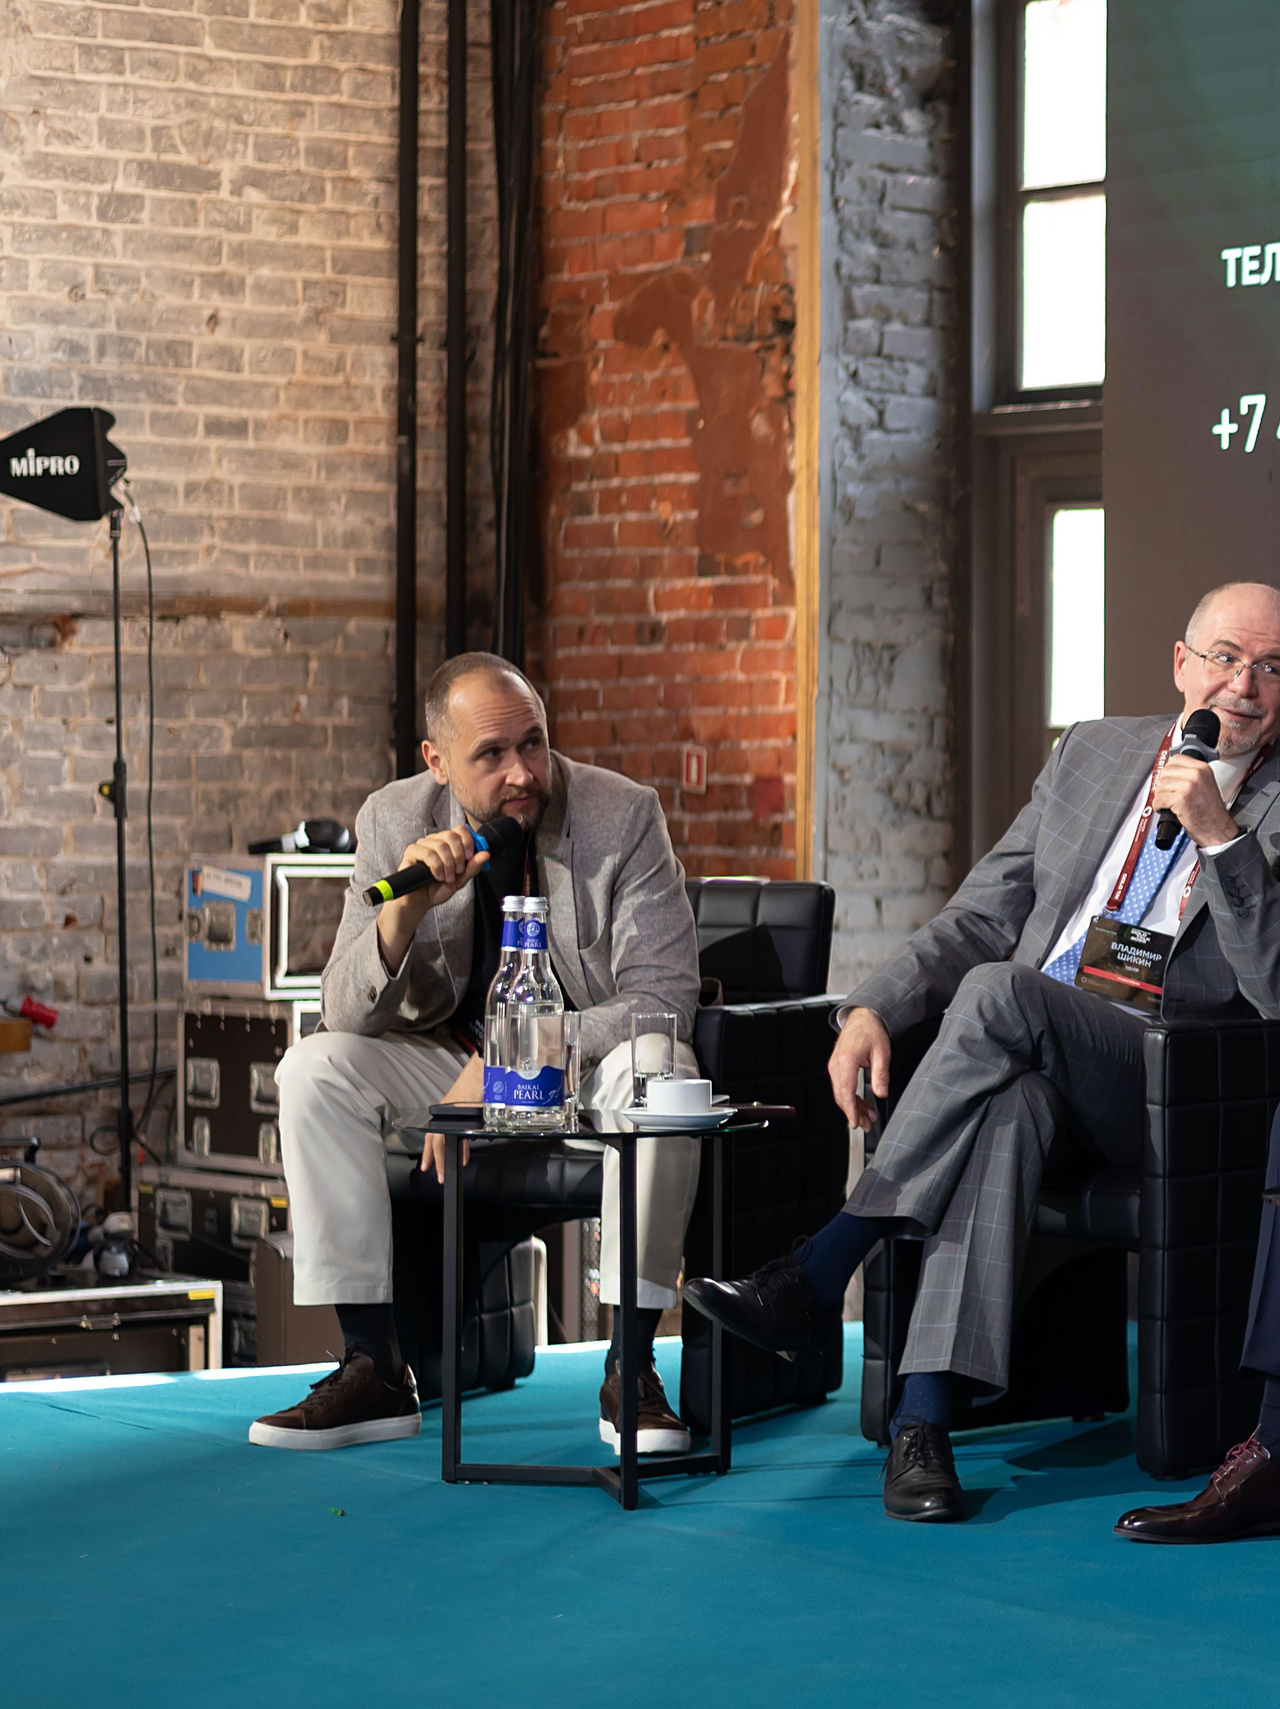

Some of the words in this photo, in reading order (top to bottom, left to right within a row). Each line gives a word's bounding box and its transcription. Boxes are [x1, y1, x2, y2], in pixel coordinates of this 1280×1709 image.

[1212, 394, 1267, 453] +7
[1111, 942, 1162, 961] ВЛАДИМИР
[1117, 952, 1152, 967] ШИКИН
[513, 1089, 545, 1100] PEARL
[517, 1083, 540, 1091] BAIKAL
